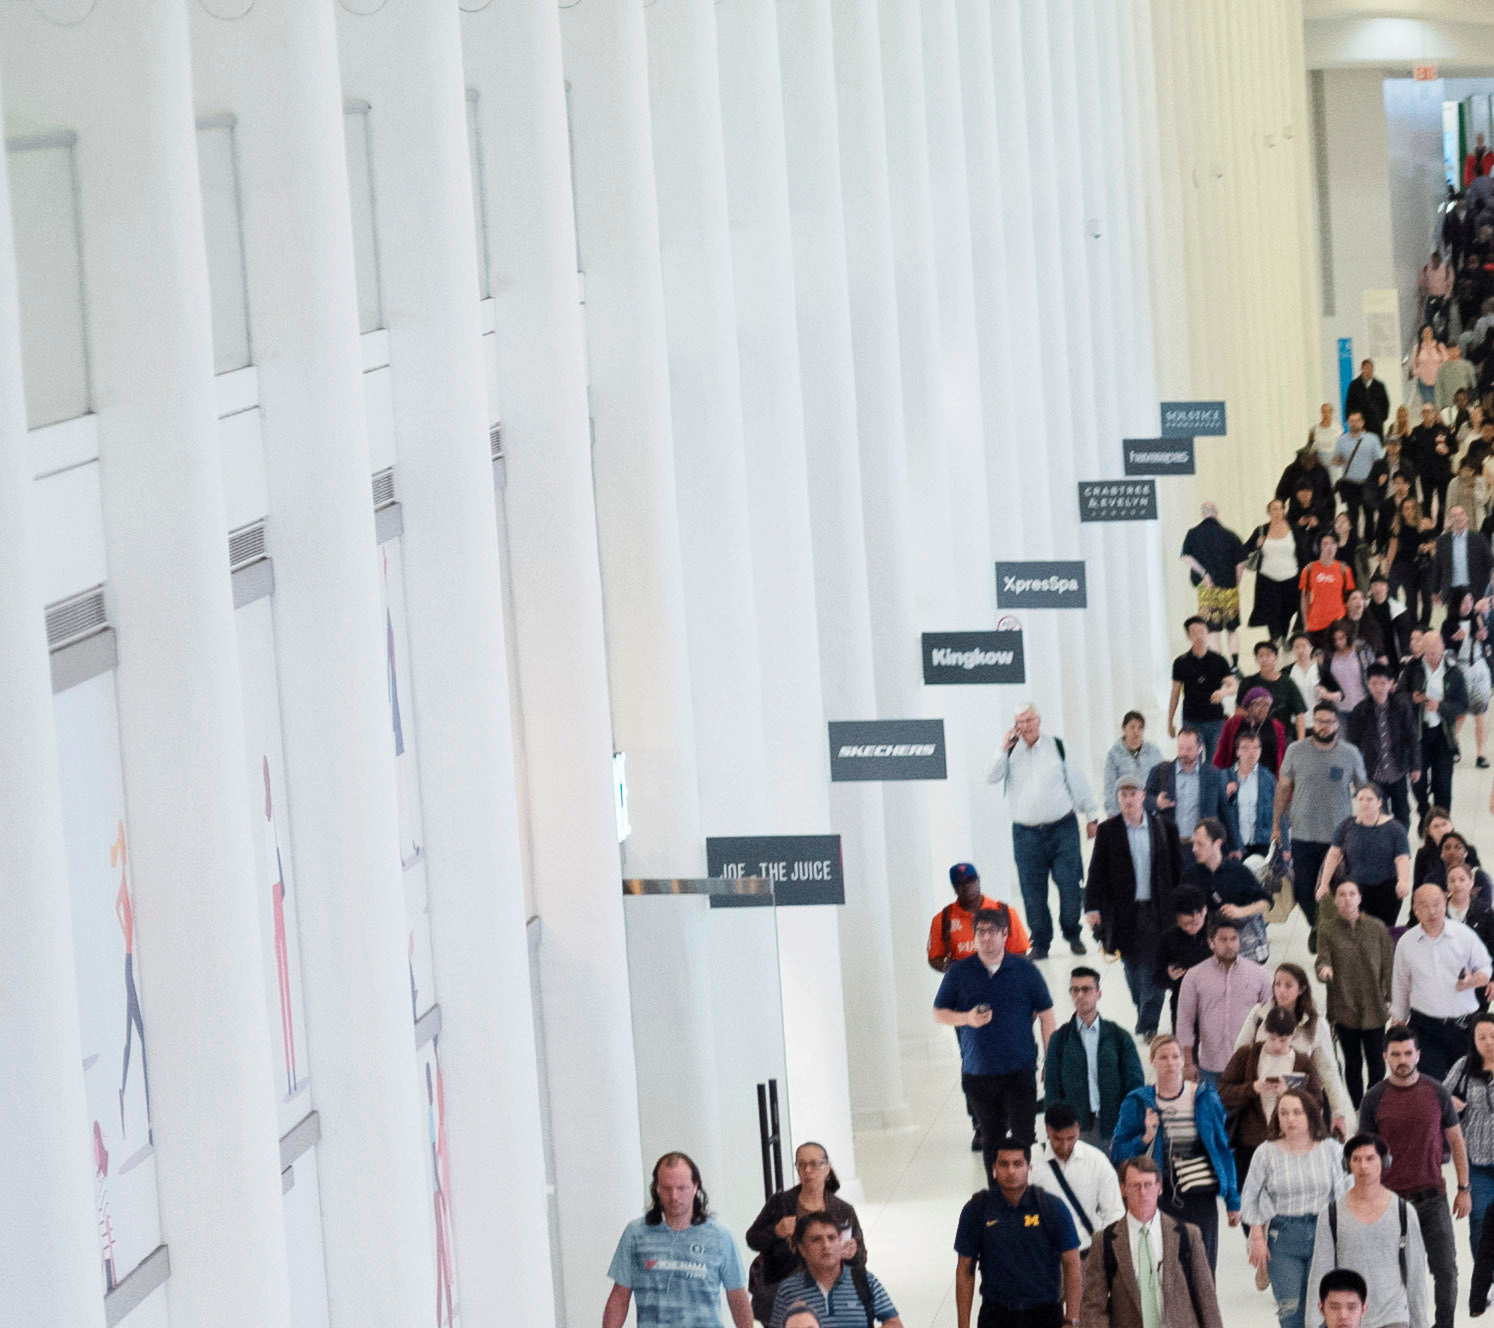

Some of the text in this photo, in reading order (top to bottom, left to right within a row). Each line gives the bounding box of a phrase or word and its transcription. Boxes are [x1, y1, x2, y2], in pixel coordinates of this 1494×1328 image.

[1003, 575, 1079, 595] XpresSpa
[931, 647, 1014, 670] Kingkow
[837, 743, 936, 758] SKECHERS
[758, 861, 788, 882] THE
[790, 860, 832, 881] JUICE
